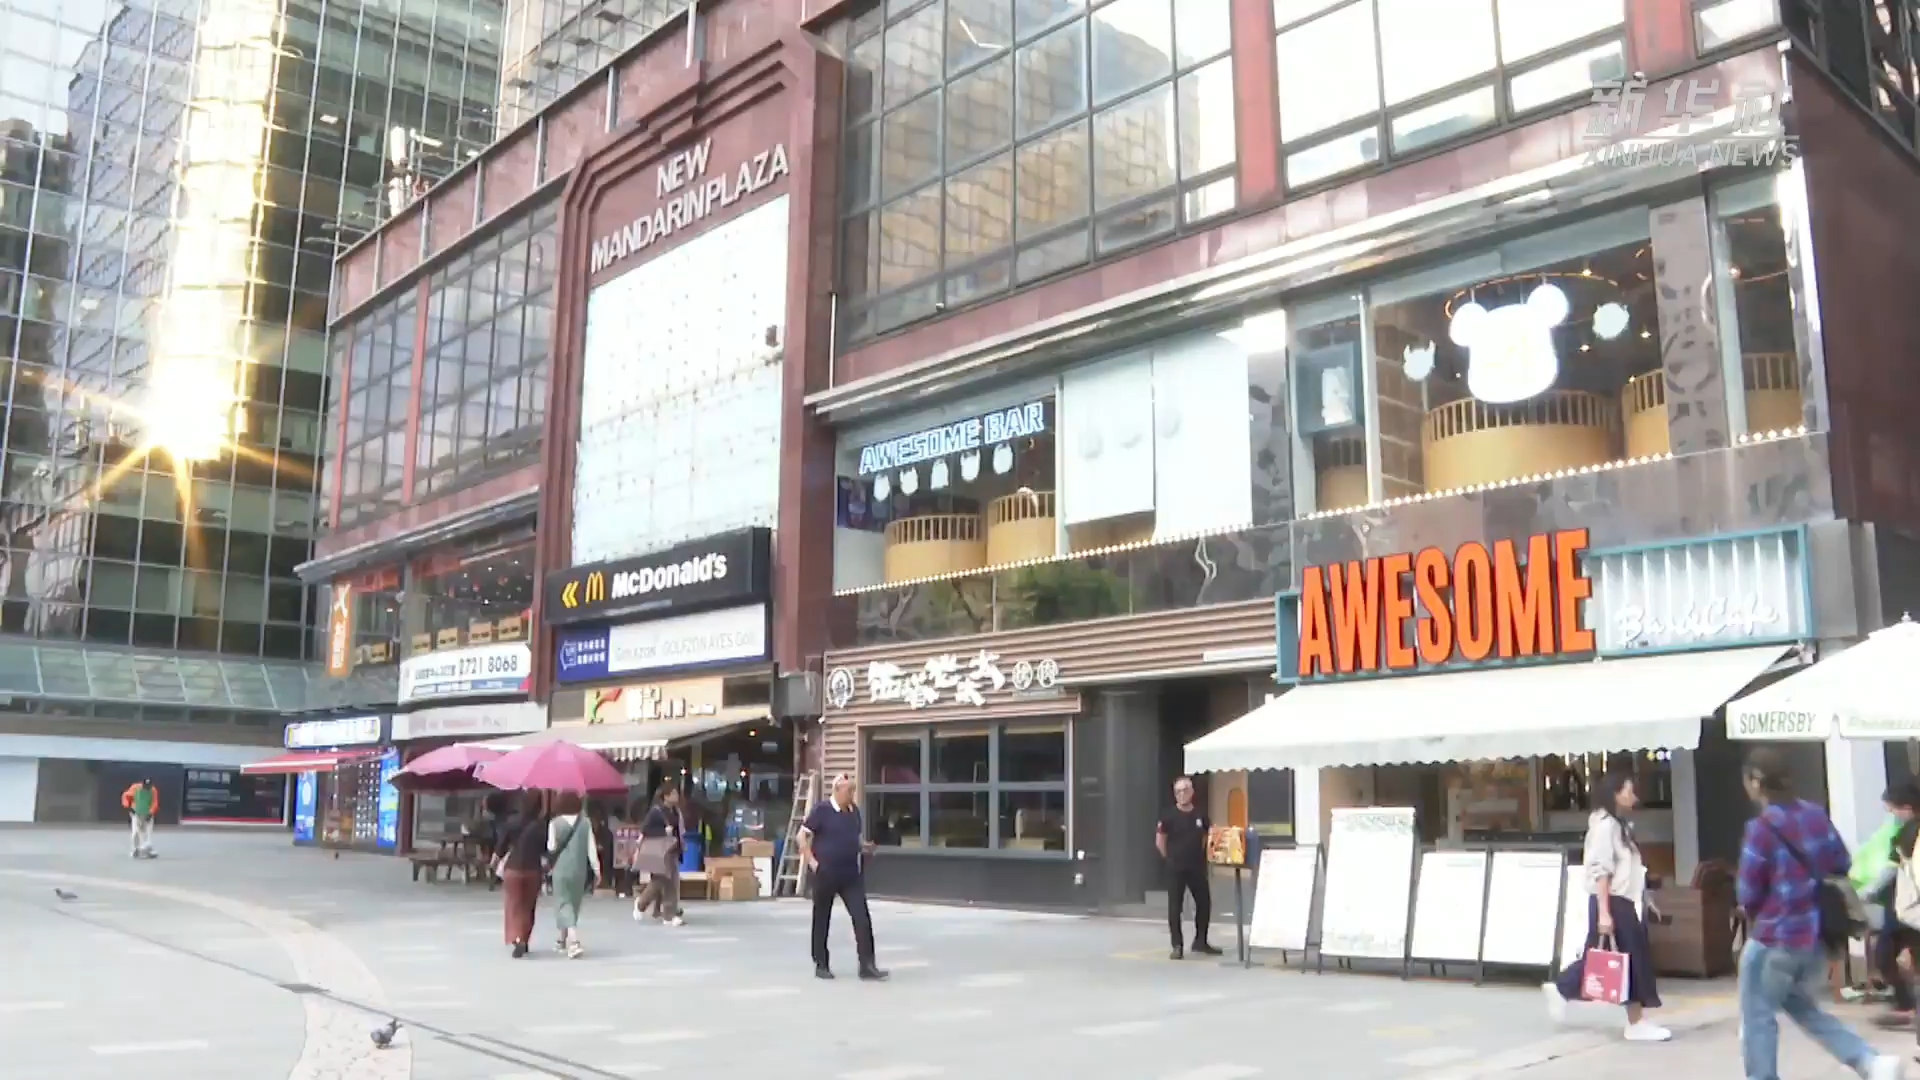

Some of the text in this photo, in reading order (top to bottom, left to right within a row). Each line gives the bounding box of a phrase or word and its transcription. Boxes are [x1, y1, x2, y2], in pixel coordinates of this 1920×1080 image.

[656, 137, 712, 198] NEW
[858, 400, 1045, 476] AWESOME BAR
[611, 552, 728, 600] McDonald's
[1298, 527, 1595, 678] AWESOME
[487, 655, 518, 673] 8068
[1739, 710, 1817, 735] SOMERSBY
